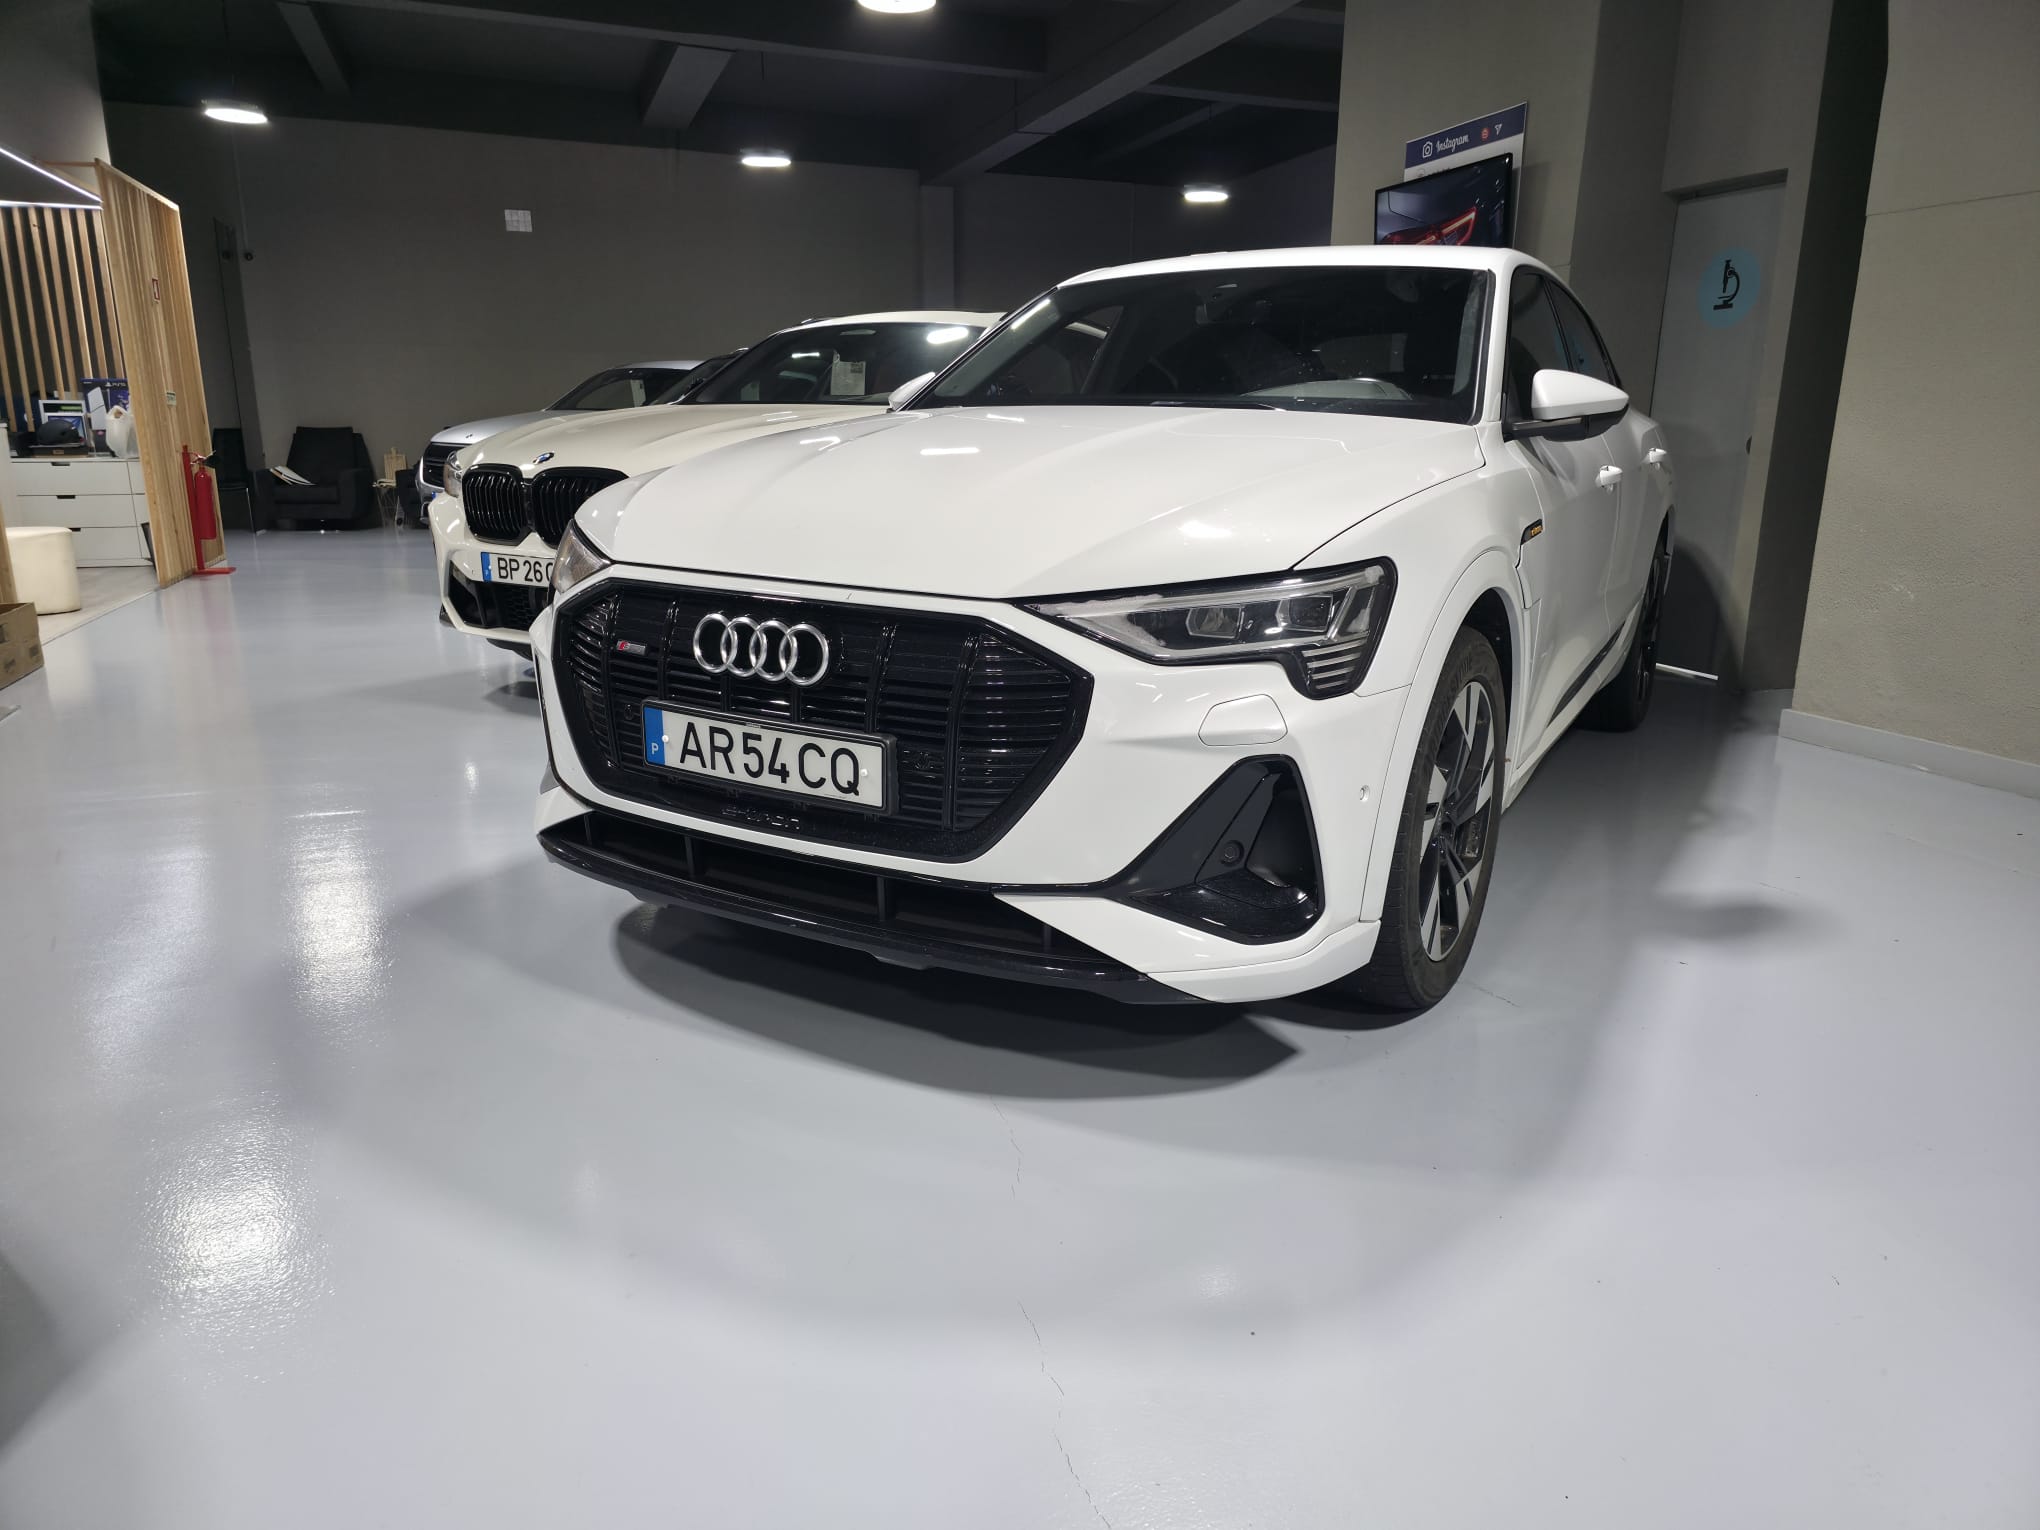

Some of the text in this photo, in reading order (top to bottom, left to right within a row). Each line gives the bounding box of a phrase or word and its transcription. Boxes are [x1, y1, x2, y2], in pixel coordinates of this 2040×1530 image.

[1435, 134, 1470, 153] Instagram
[497, 557, 520, 580] BP
[523, 560, 543, 583] 26
[651, 742, 659, 755] P
